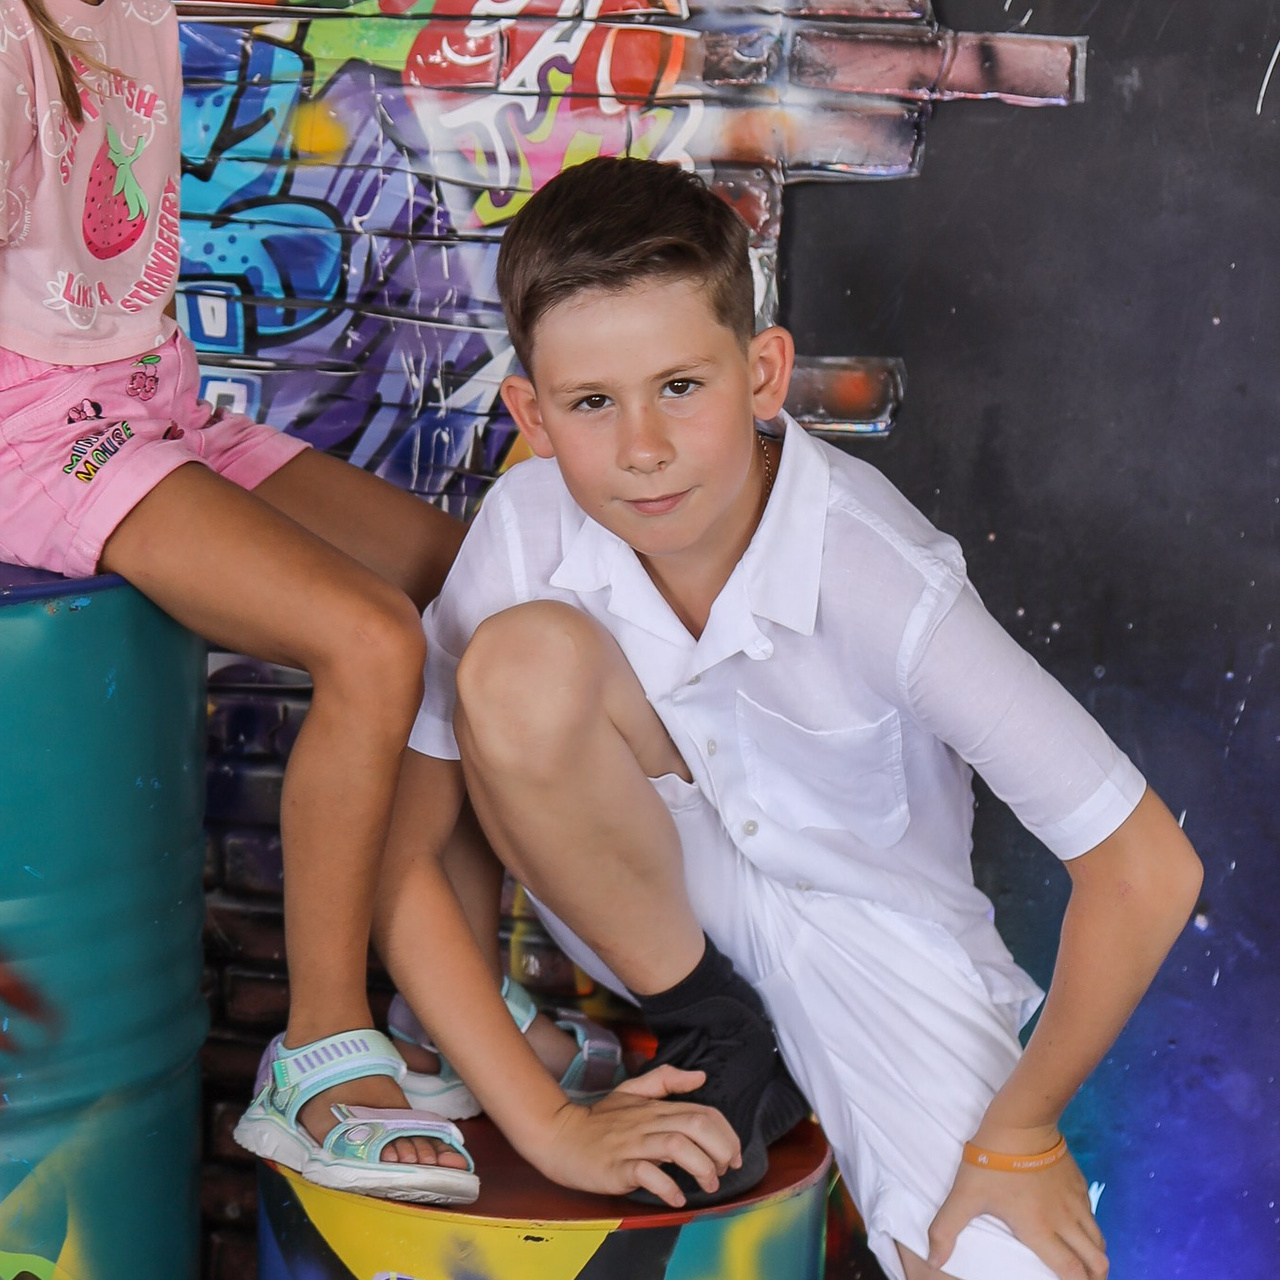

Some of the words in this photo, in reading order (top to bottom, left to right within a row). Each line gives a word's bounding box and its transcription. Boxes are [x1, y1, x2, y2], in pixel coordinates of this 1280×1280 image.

[97, 281, 115, 307] A
[119, 174, 180, 314] STRAWBERRY
[75, 420, 136, 484] MOUSE
